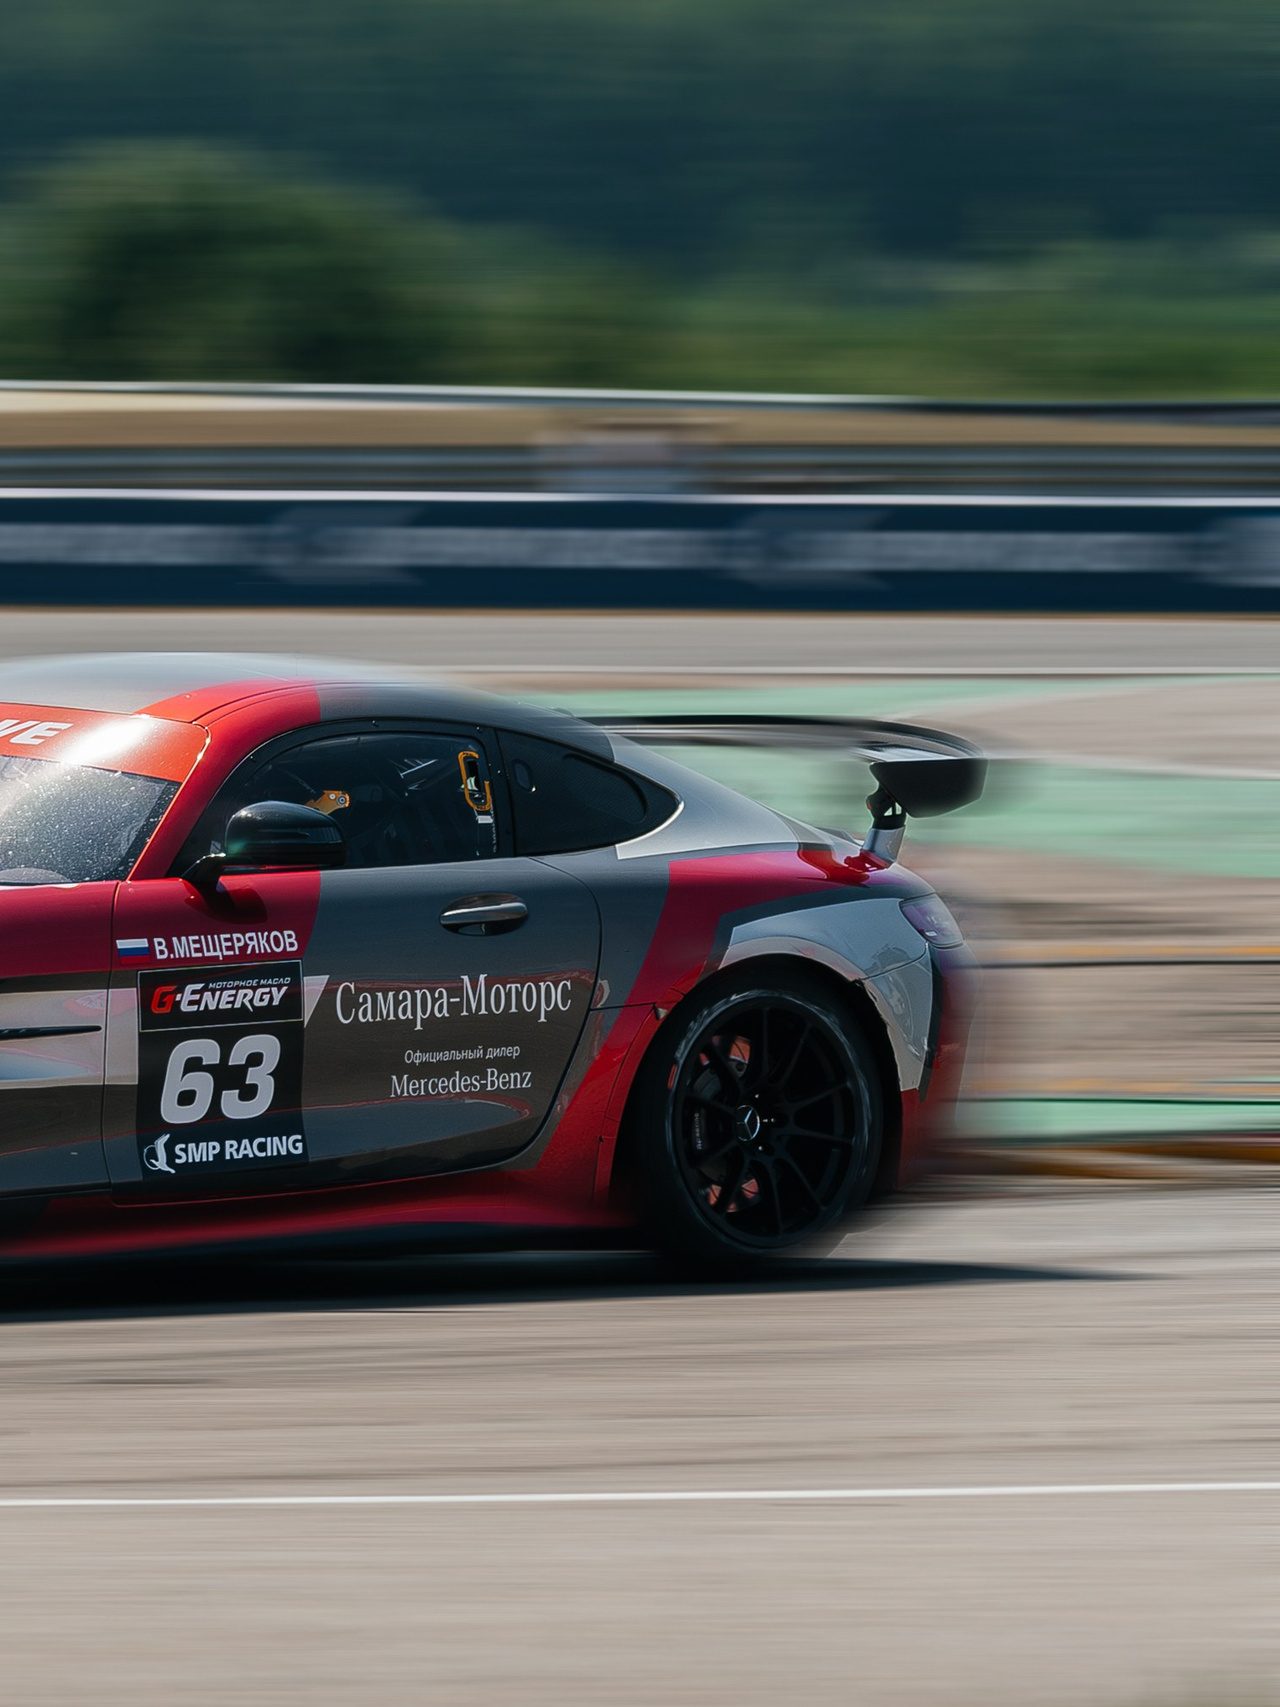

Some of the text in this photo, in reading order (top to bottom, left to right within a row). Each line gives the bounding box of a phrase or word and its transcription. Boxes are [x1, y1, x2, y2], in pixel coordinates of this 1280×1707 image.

[153, 930, 299, 960] В.МЕЩЕРЯКОВ
[208, 977, 291, 989] МОТОРНОЕ МАСЛО
[335, 974, 572, 1030] Самара-Моторс
[404, 1045, 521, 1066] Официальный дилер
[160, 1034, 281, 1124] 63
[389, 1067, 532, 1098] Mercedes-Benz
[174, 1134, 303, 1164] SMP RACING
